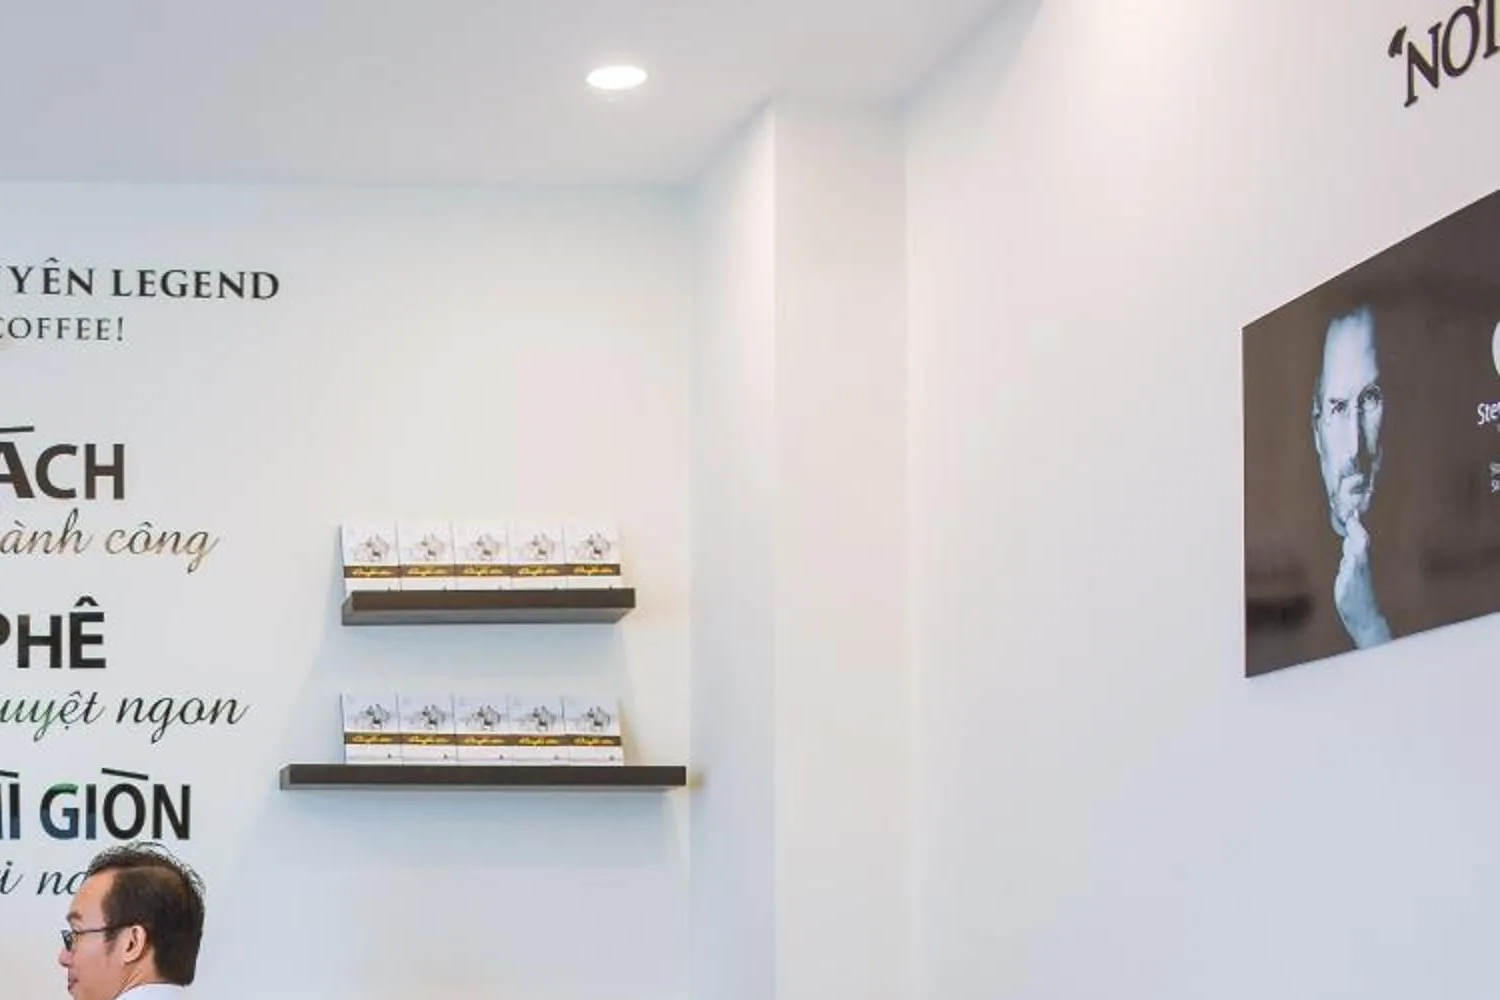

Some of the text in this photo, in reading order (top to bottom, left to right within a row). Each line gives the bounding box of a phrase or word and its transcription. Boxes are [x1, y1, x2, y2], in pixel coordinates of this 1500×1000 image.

[109, 268, 280, 300] LEGEND
[1477, 402, 1500, 425] Ste
[104, 520, 220, 574] công
[115, 696, 250, 745] ngon
